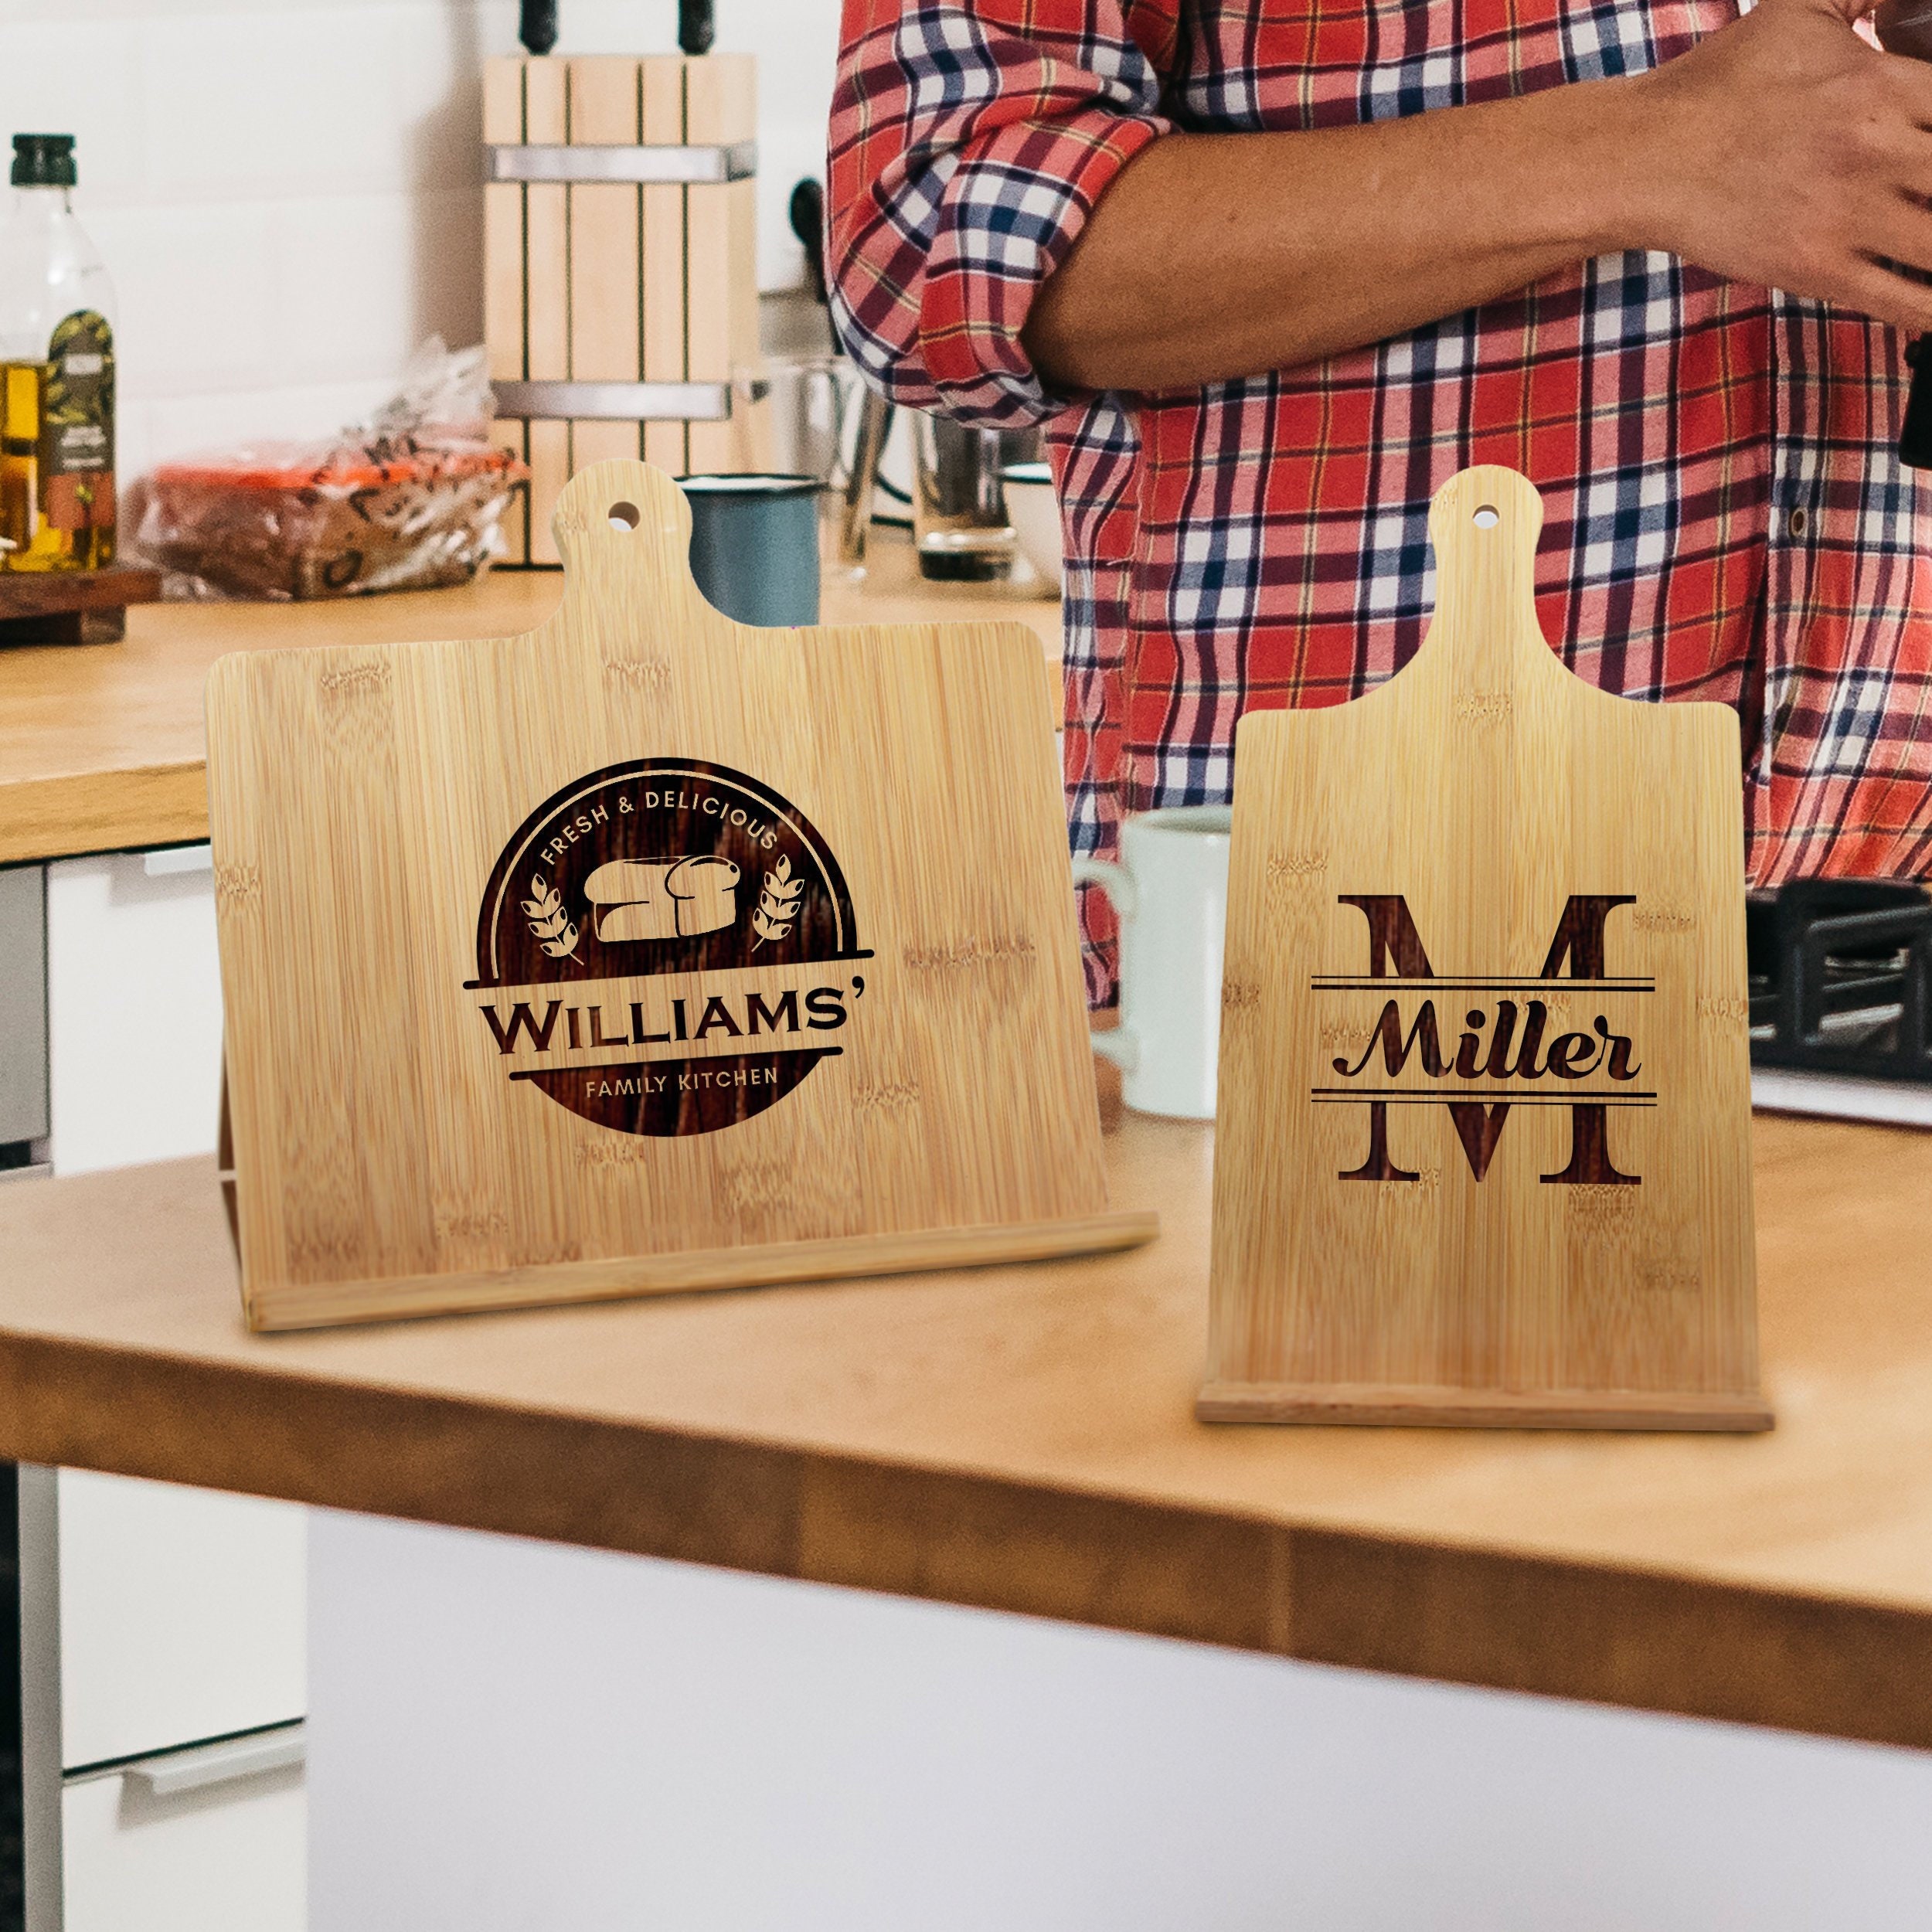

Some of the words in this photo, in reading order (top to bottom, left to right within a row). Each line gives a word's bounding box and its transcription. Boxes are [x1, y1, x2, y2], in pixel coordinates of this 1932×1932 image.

[540, 804, 609, 866] FRESH
[618, 796, 634, 814] &
[645, 791, 778, 850] DELICIOUS
[1332, 999, 1642, 1081] Miller
[586, 1076, 667, 1098] FAMILY
[678, 1067, 777, 1090] KITCHEN
